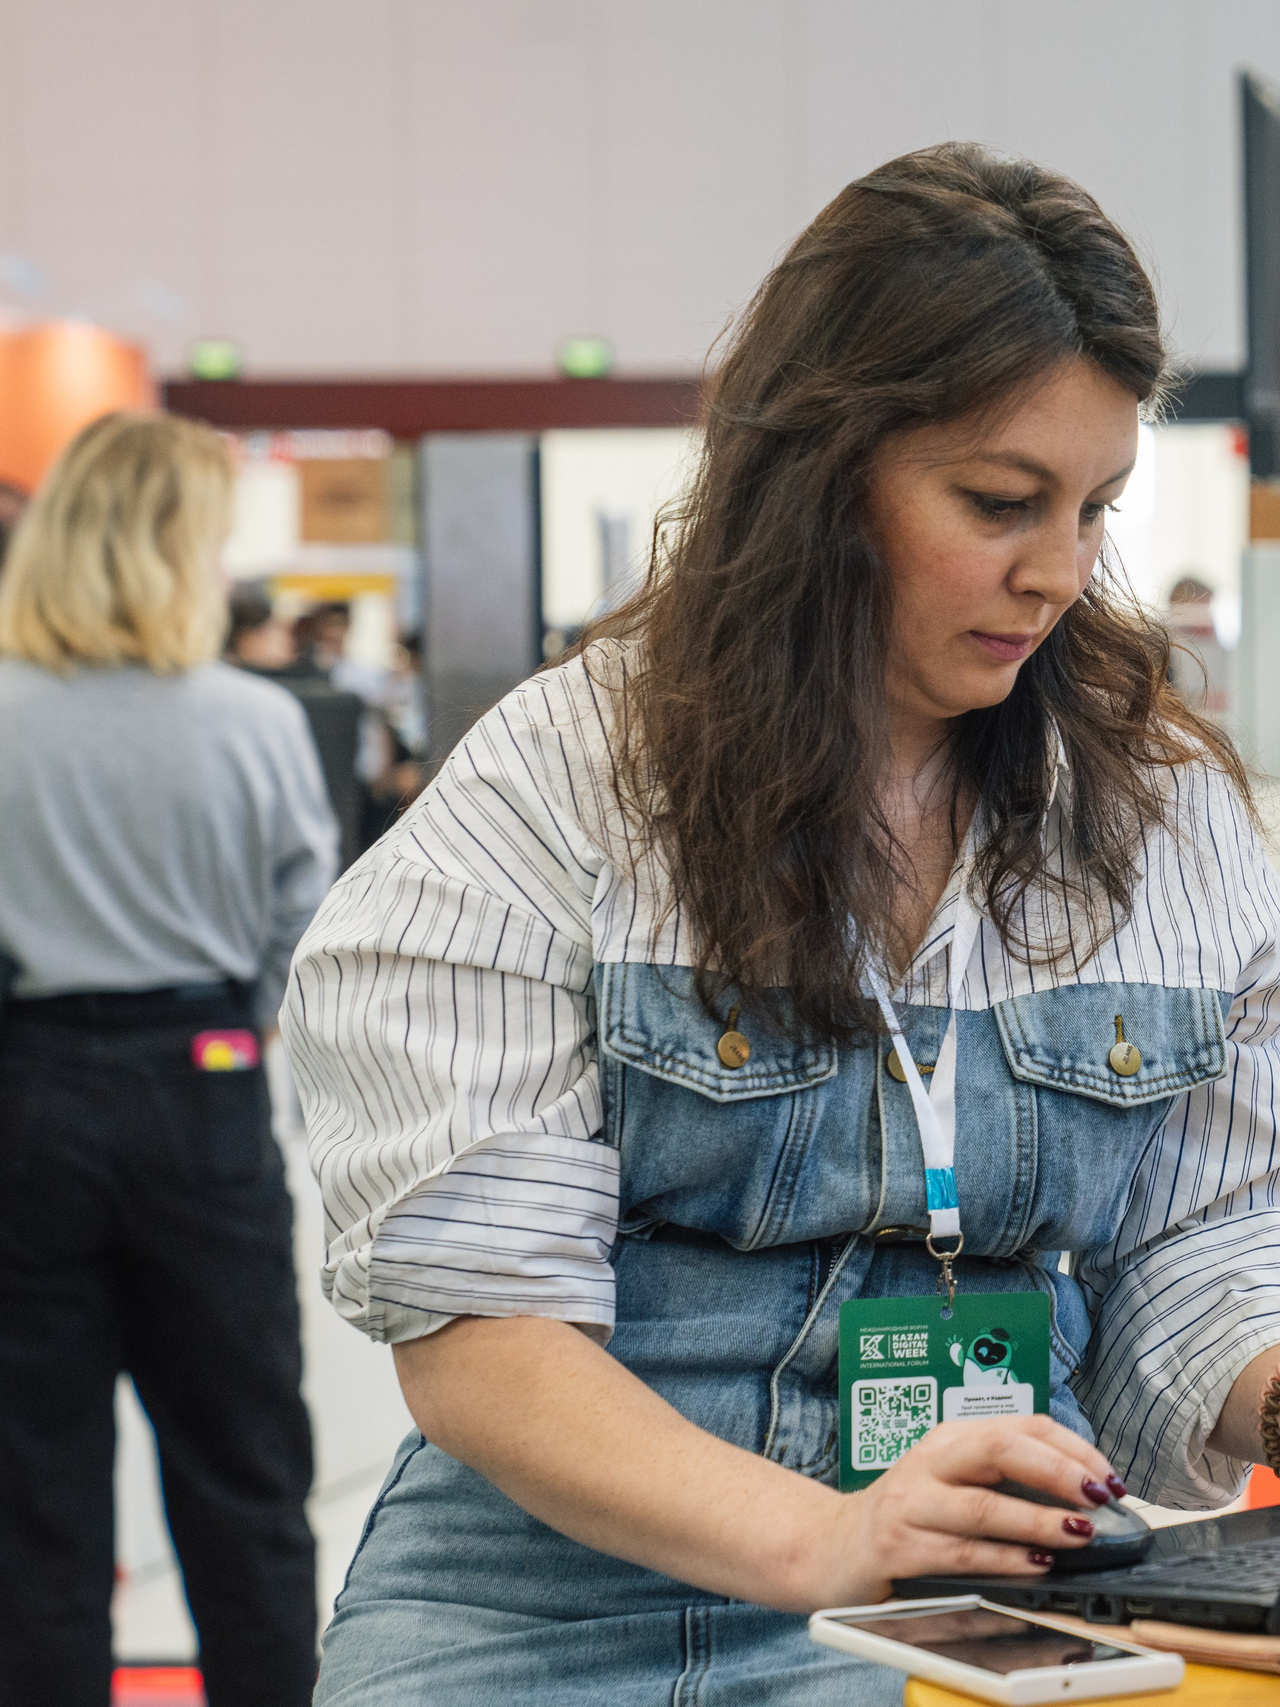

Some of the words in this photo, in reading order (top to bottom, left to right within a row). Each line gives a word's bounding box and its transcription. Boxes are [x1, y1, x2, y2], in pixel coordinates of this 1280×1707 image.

[1123, 1045, 1133, 1065] JEANS
[892, 1332, 928, 1341] KAZAN
[892, 1340, 928, 1349] DIGITAL
[892, 1348, 928, 1358] WEEK
[860, 1361, 907, 1369] INTERNATIONAL
